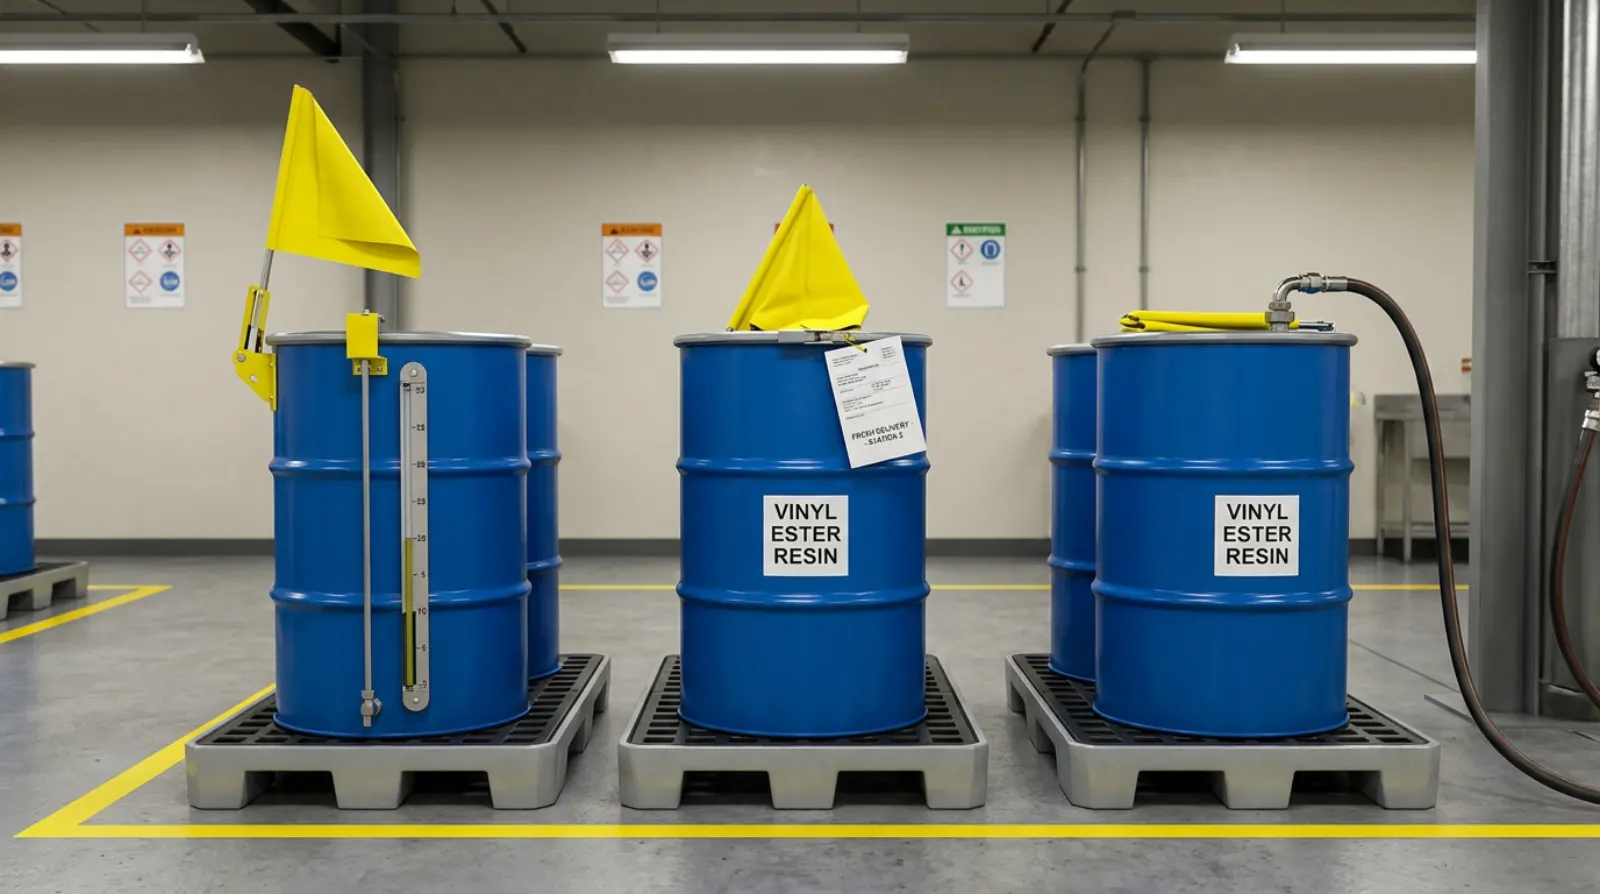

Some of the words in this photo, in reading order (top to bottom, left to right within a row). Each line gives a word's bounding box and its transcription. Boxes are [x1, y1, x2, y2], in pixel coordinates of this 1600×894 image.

[774, 503, 838, 520] VINYL
[1226, 503, 1289, 520] VINYL
[771, 525, 842, 542] ESTER
[1223, 525, 1292, 542] ESTER
[774, 547, 838, 565] RESIN
[1226, 547, 1289, 565] RESIN
